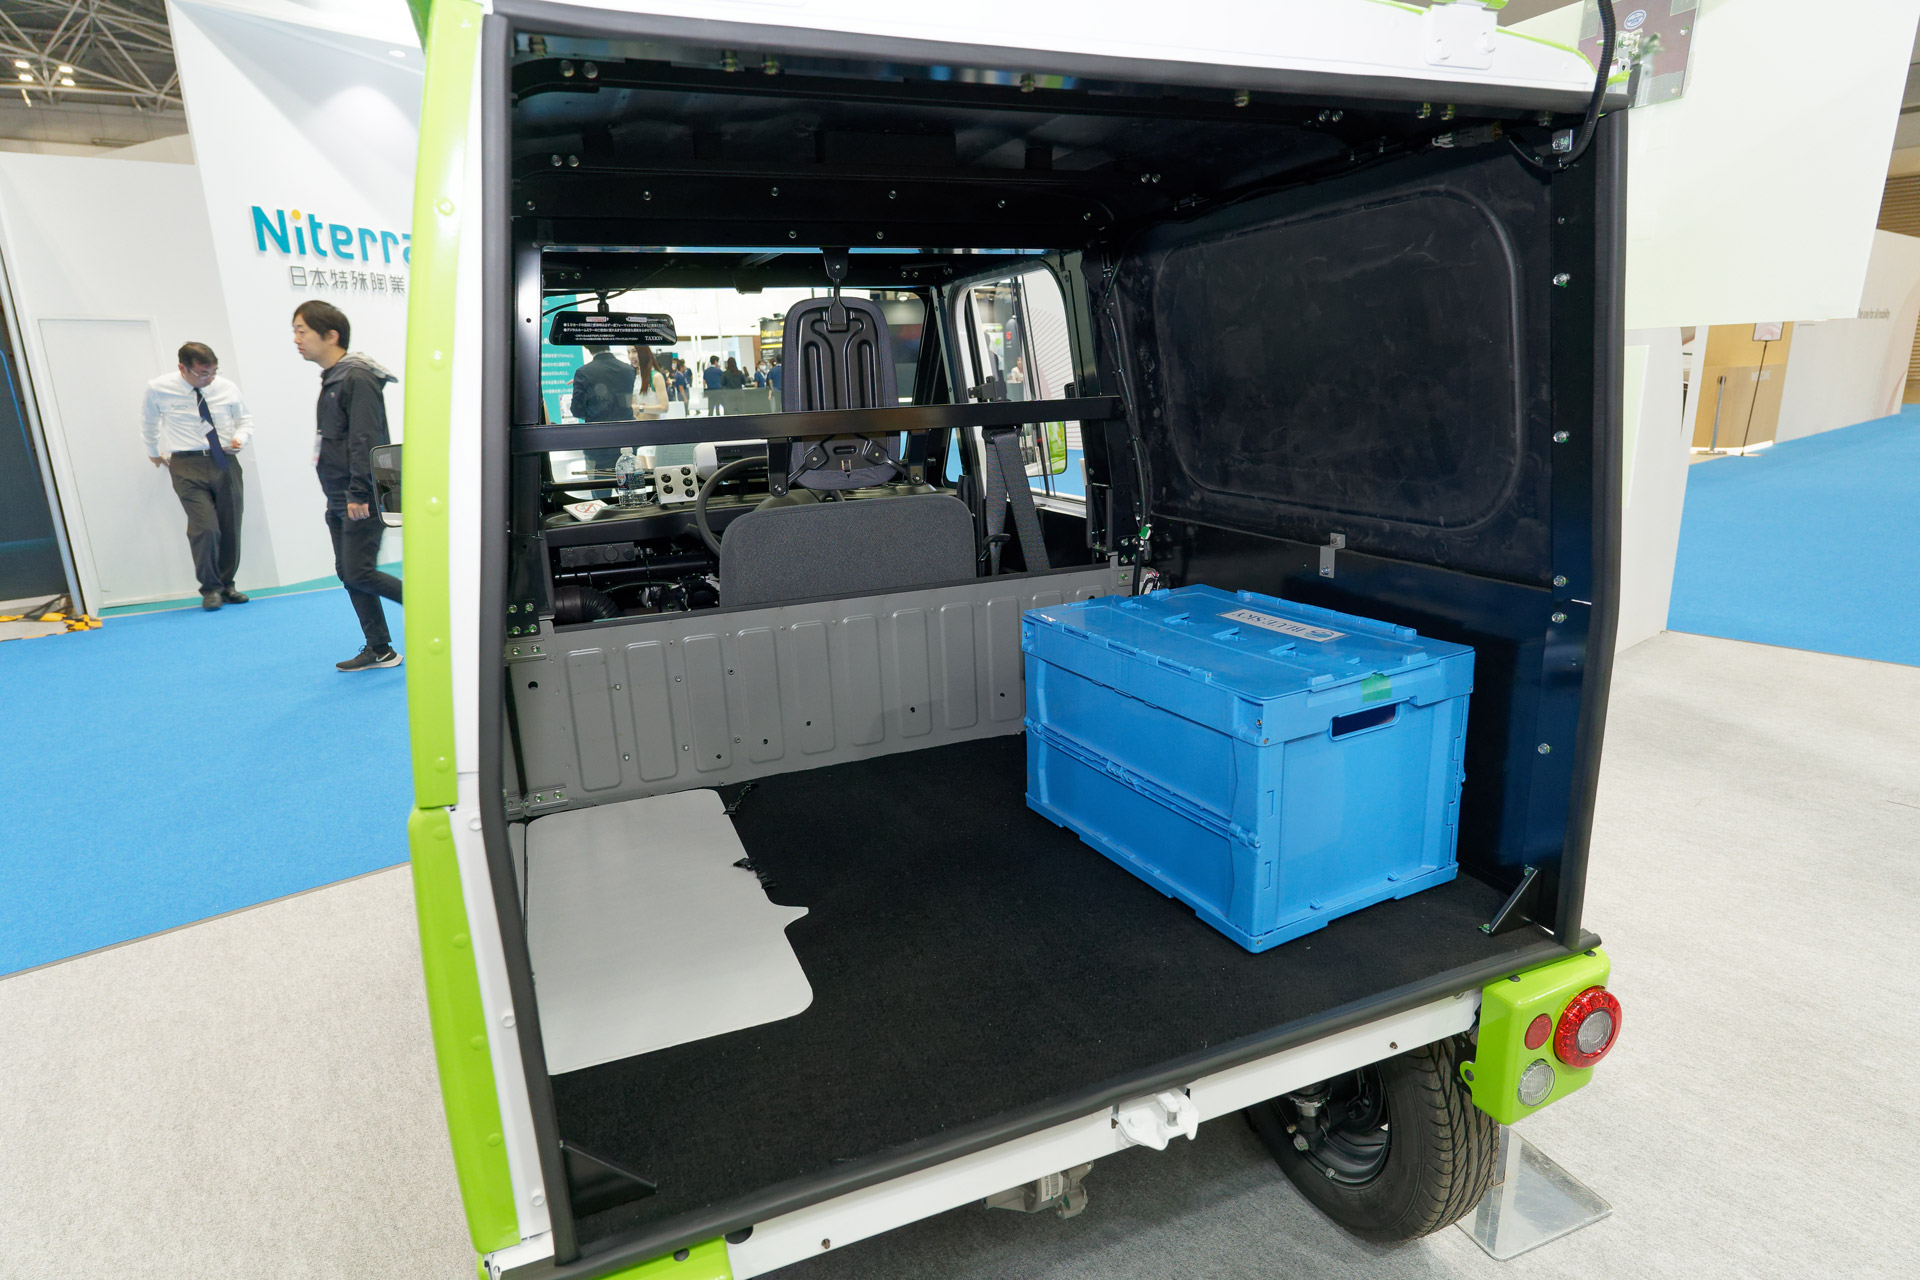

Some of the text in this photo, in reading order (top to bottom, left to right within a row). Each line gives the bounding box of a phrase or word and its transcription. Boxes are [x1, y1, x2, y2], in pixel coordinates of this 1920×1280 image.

[290, 265, 406, 293] 日本特殊陶業
